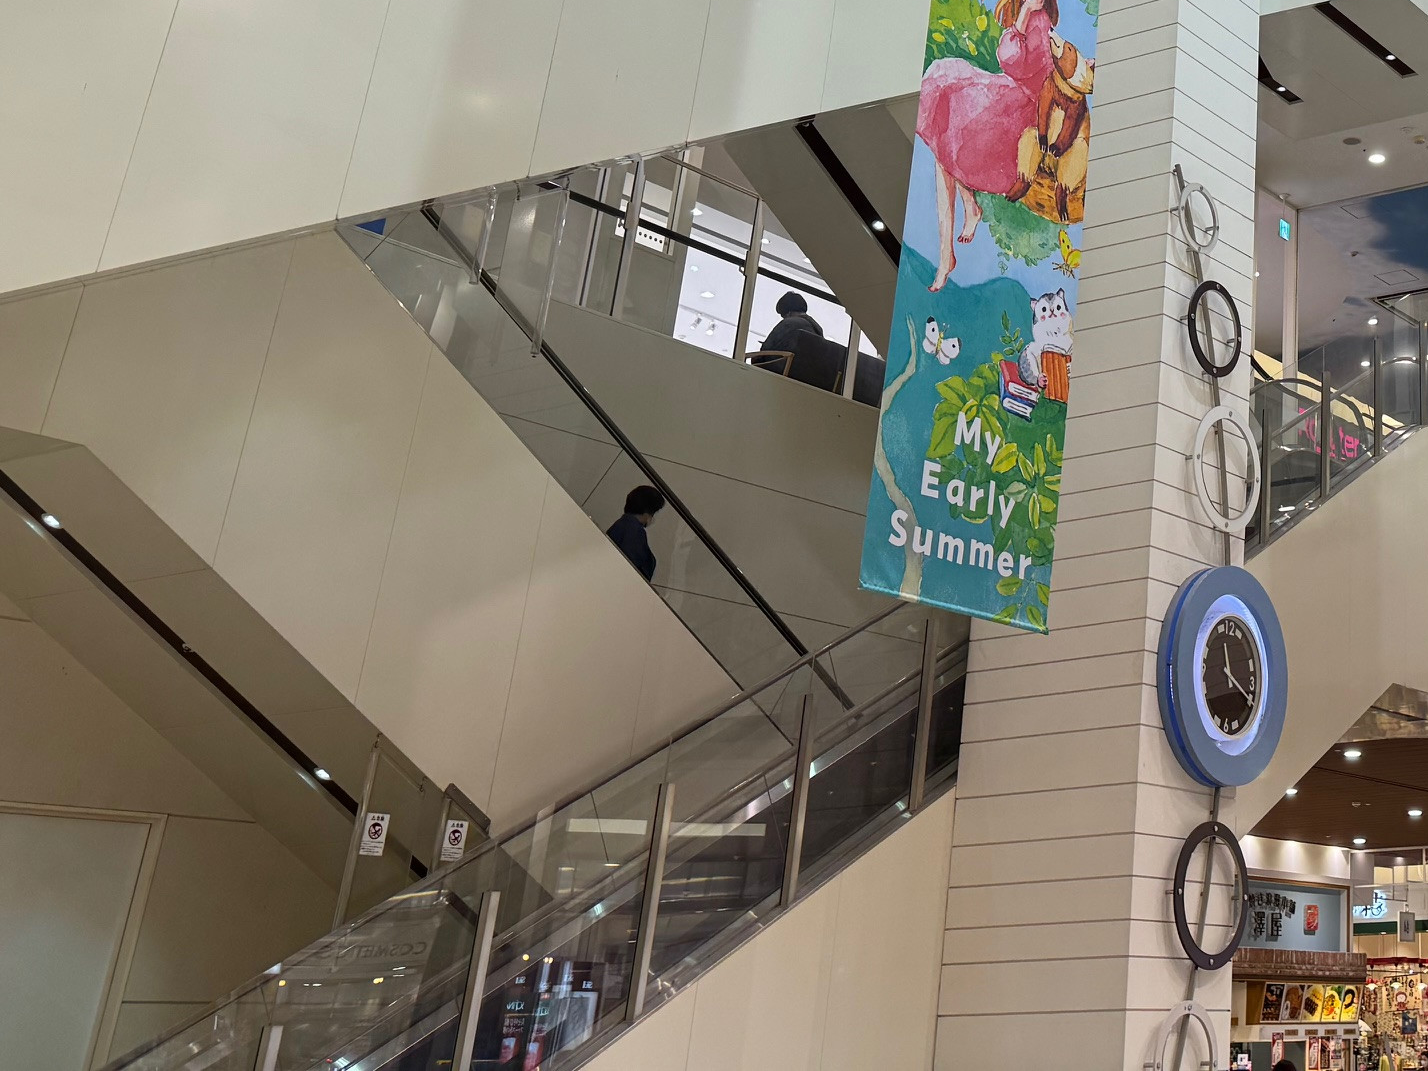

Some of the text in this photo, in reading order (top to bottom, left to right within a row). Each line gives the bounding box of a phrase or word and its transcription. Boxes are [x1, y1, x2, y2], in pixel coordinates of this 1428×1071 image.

[953, 411, 1002, 465] My
[920, 460, 1016, 528] Early
[888, 509, 1032, 579] Summer
[1225, 620, 1235, 636] 12
[1249, 676, 1255, 691] 3
[1223, 718, 1229, 733] 6
